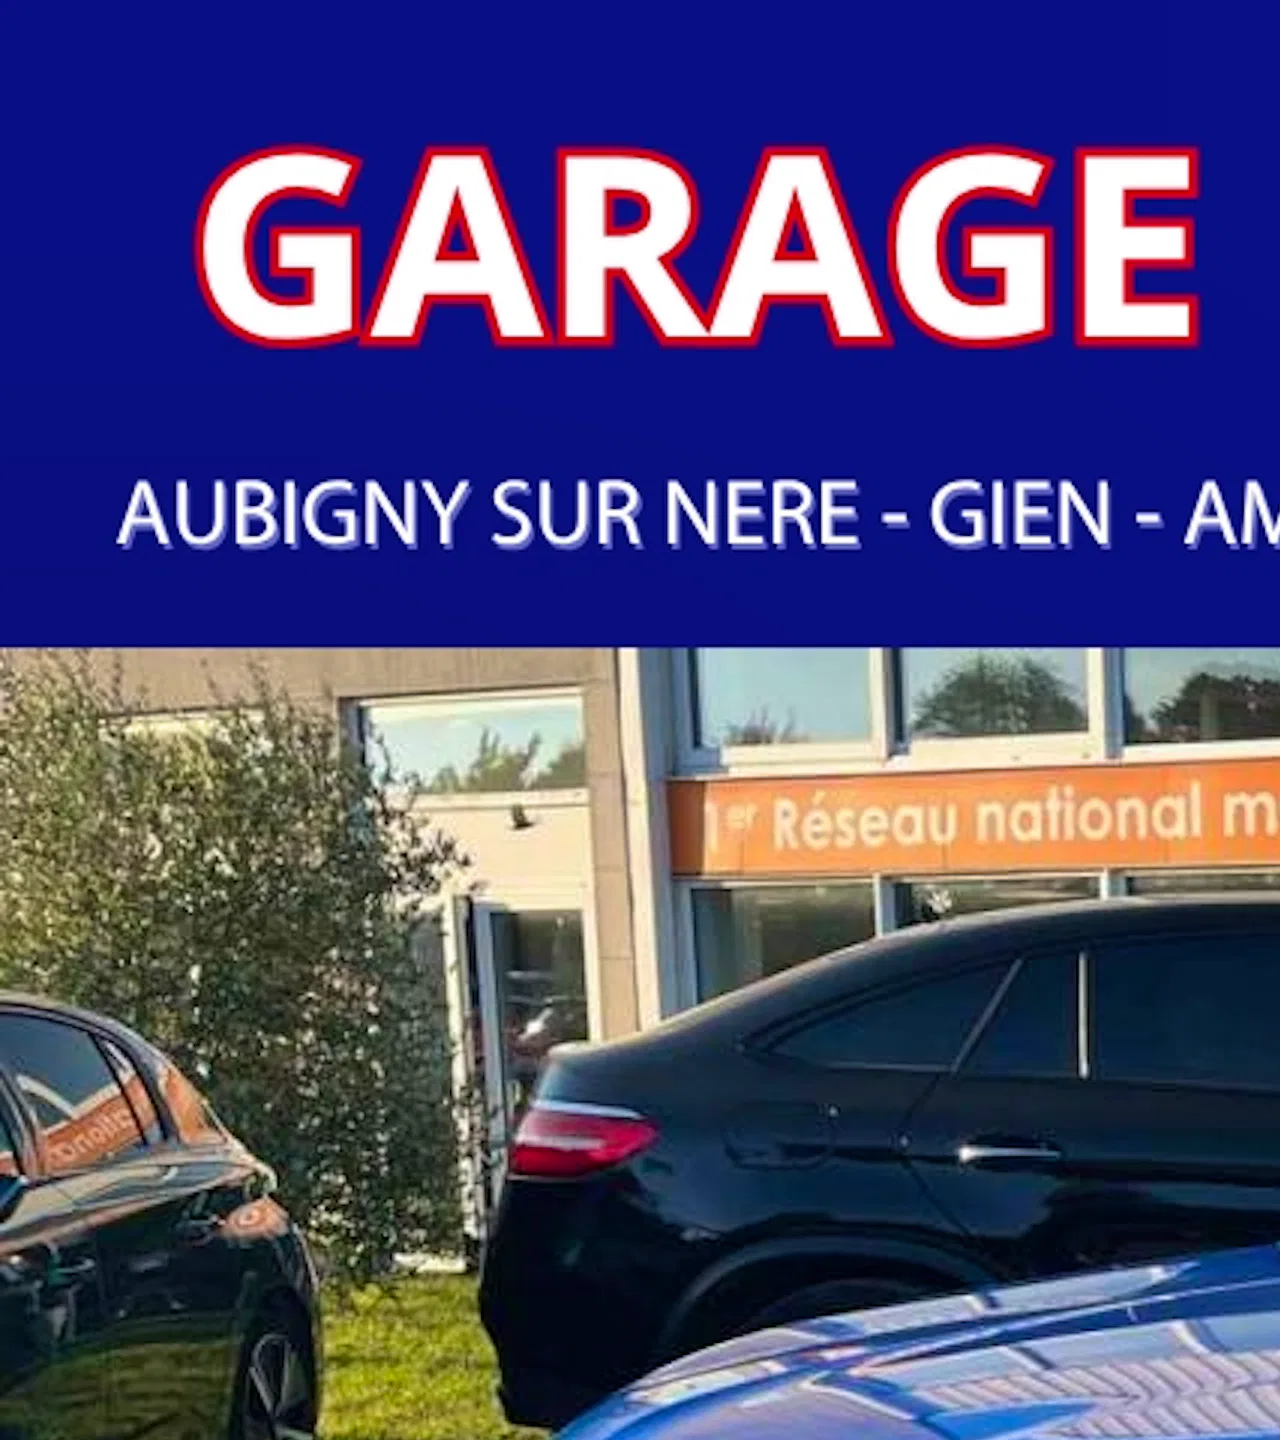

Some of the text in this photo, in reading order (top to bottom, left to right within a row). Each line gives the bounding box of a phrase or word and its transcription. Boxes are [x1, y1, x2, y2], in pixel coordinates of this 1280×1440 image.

[703, 800, 757, 853] 1er
[772, 789, 957, 850] Réseau
[975, 780, 1202, 842] national
